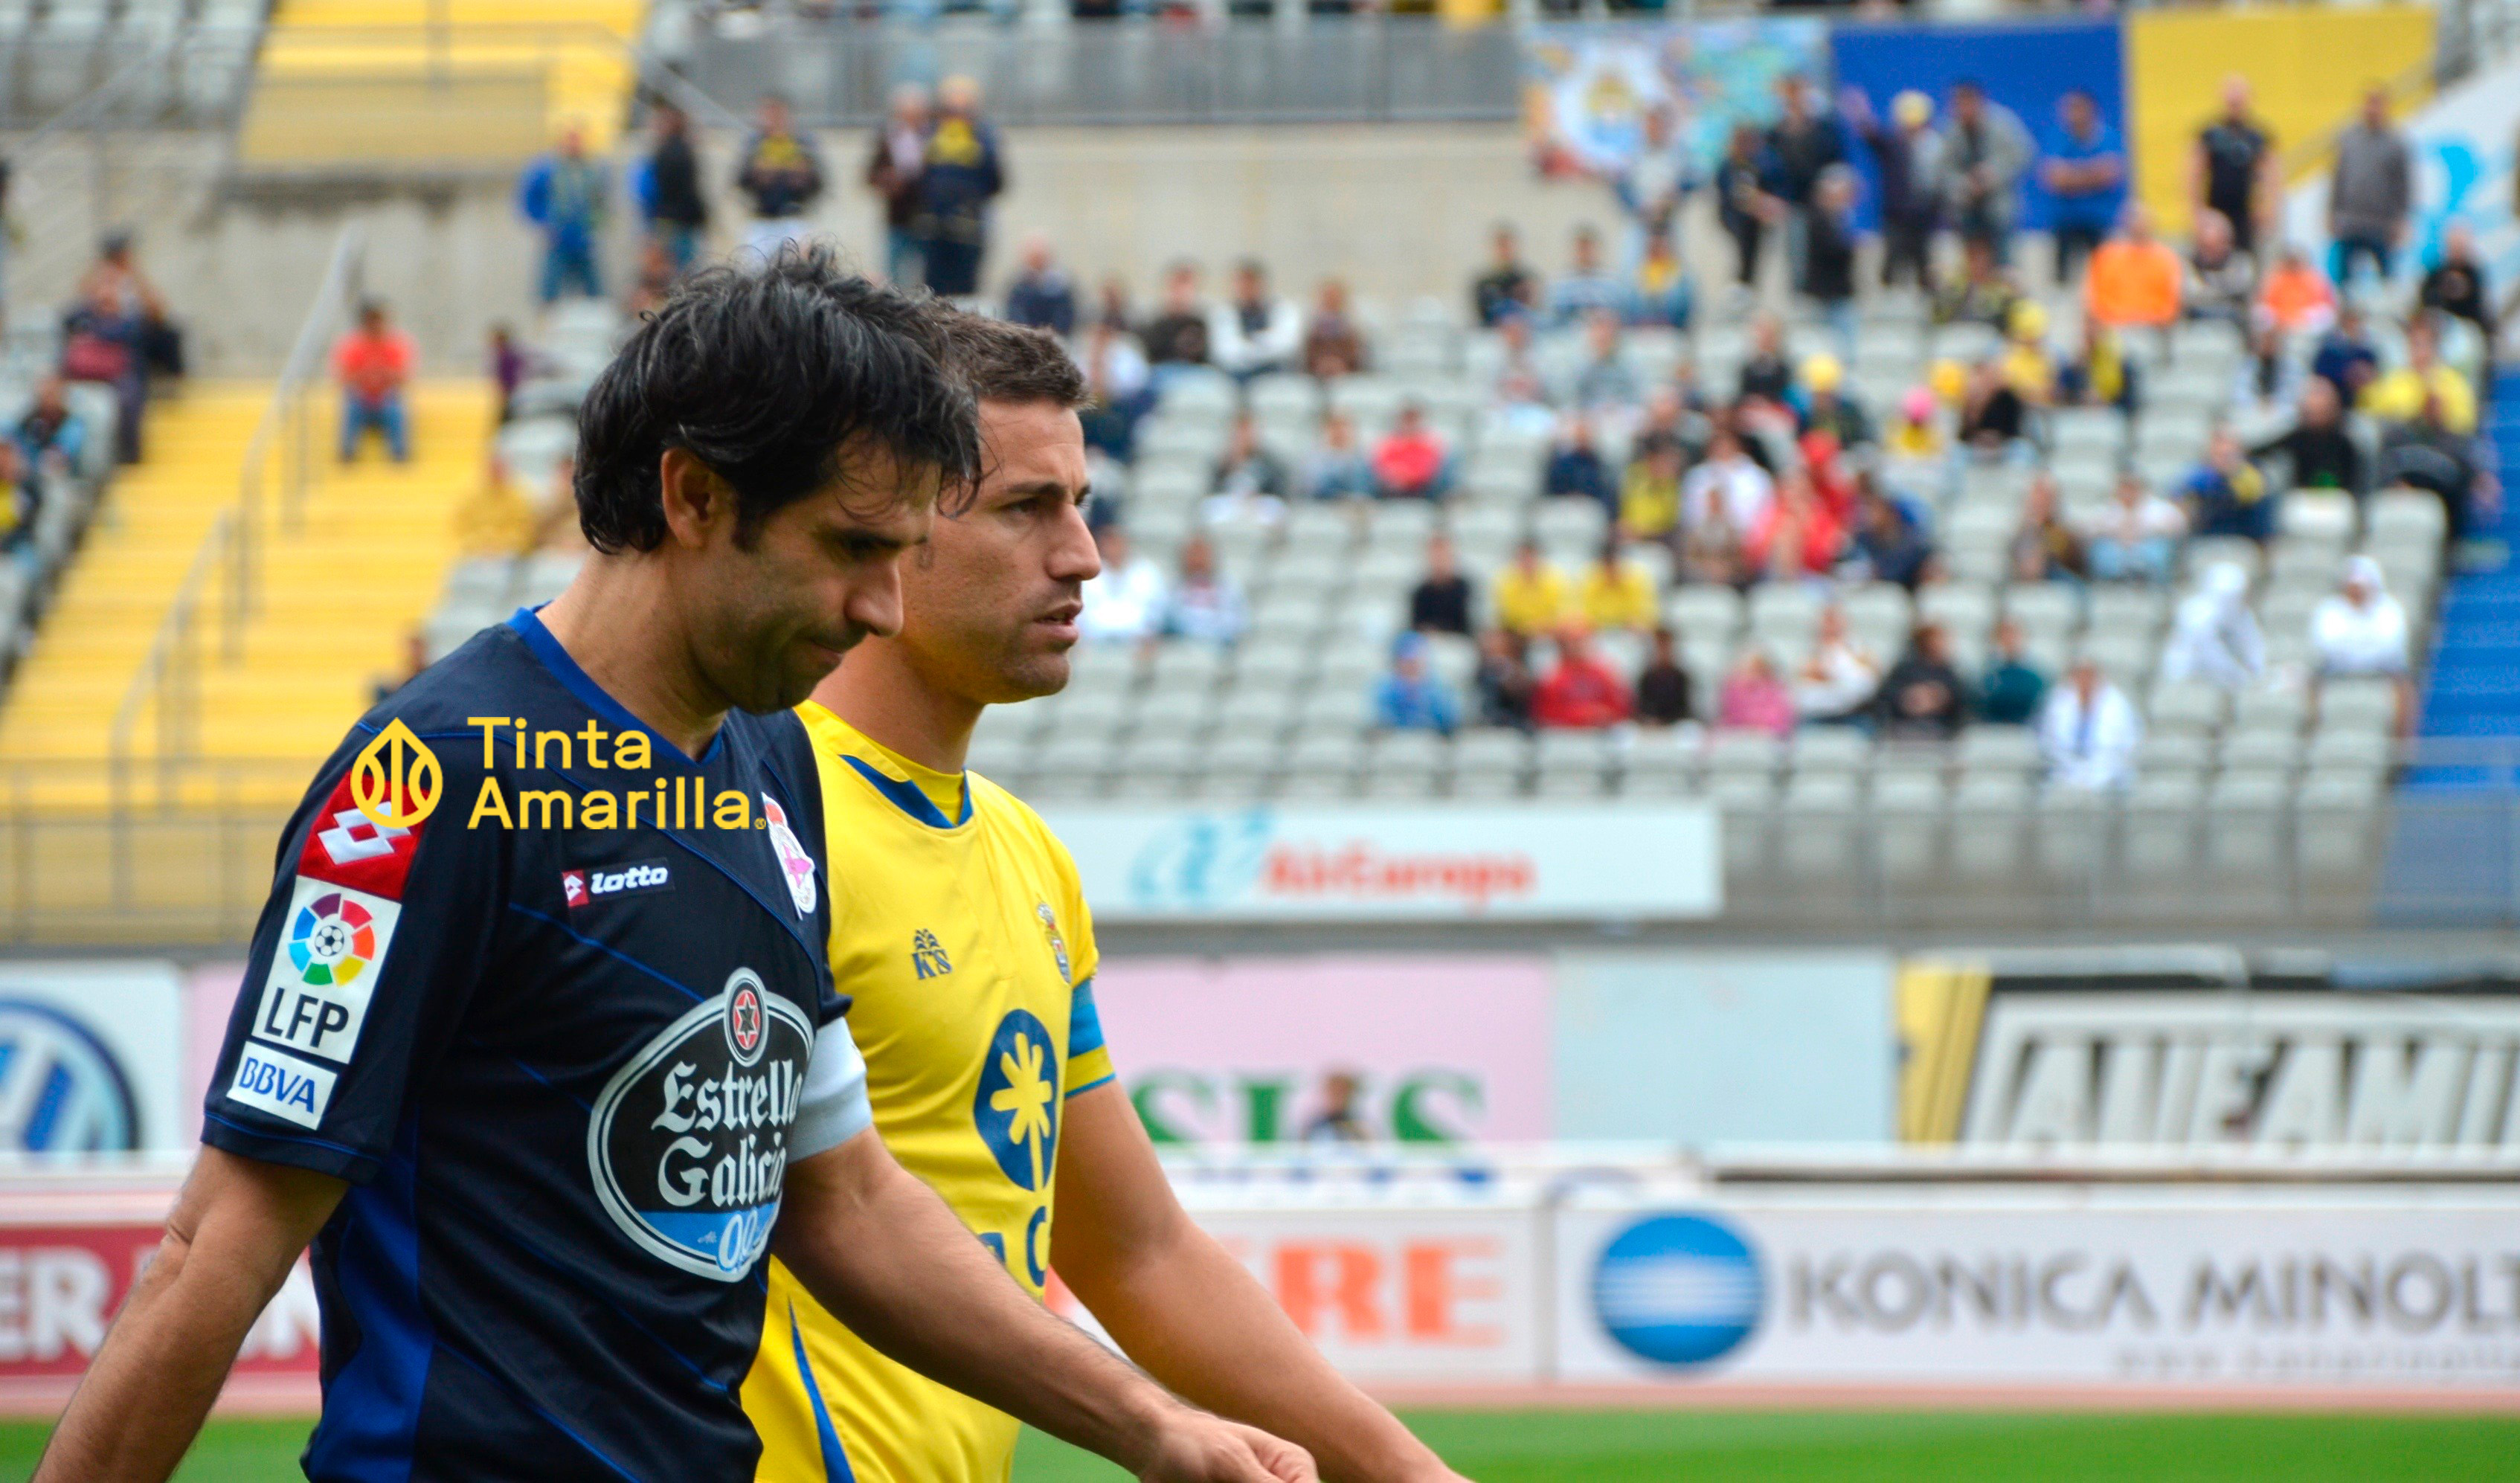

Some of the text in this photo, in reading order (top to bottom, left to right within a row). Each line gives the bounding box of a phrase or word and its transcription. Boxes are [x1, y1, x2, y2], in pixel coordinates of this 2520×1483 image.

[591, 865, 669, 895] lotto
[264, 987, 350, 1049] LFP
[239, 1056, 316, 1114] BBVA
[1220, 1238, 1502, 1345] RE
[1791, 1251, 2156, 1336] KONICA
